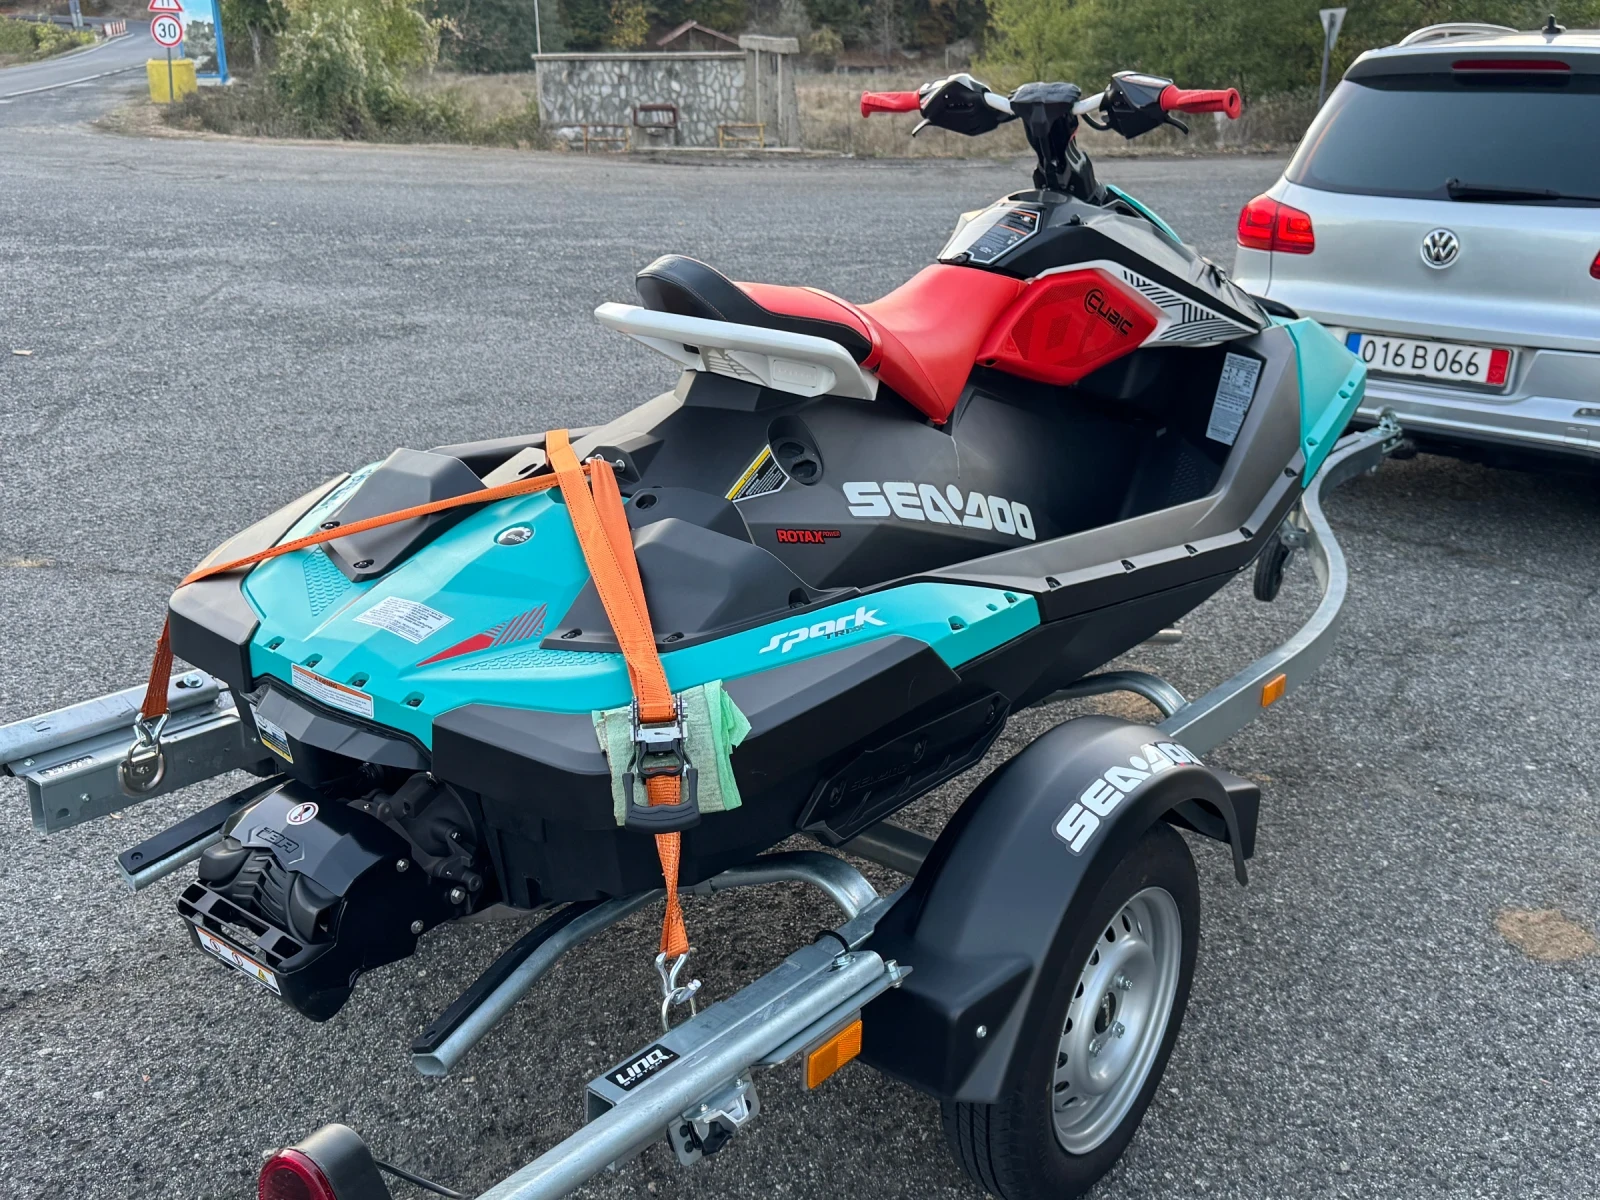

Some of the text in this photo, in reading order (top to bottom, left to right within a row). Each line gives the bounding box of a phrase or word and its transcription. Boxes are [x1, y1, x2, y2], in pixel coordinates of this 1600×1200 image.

[158, 23, 177, 39] 30
[1084, 289, 1134, 336] CUBIC
[777, 530, 824, 543] ROTAX
